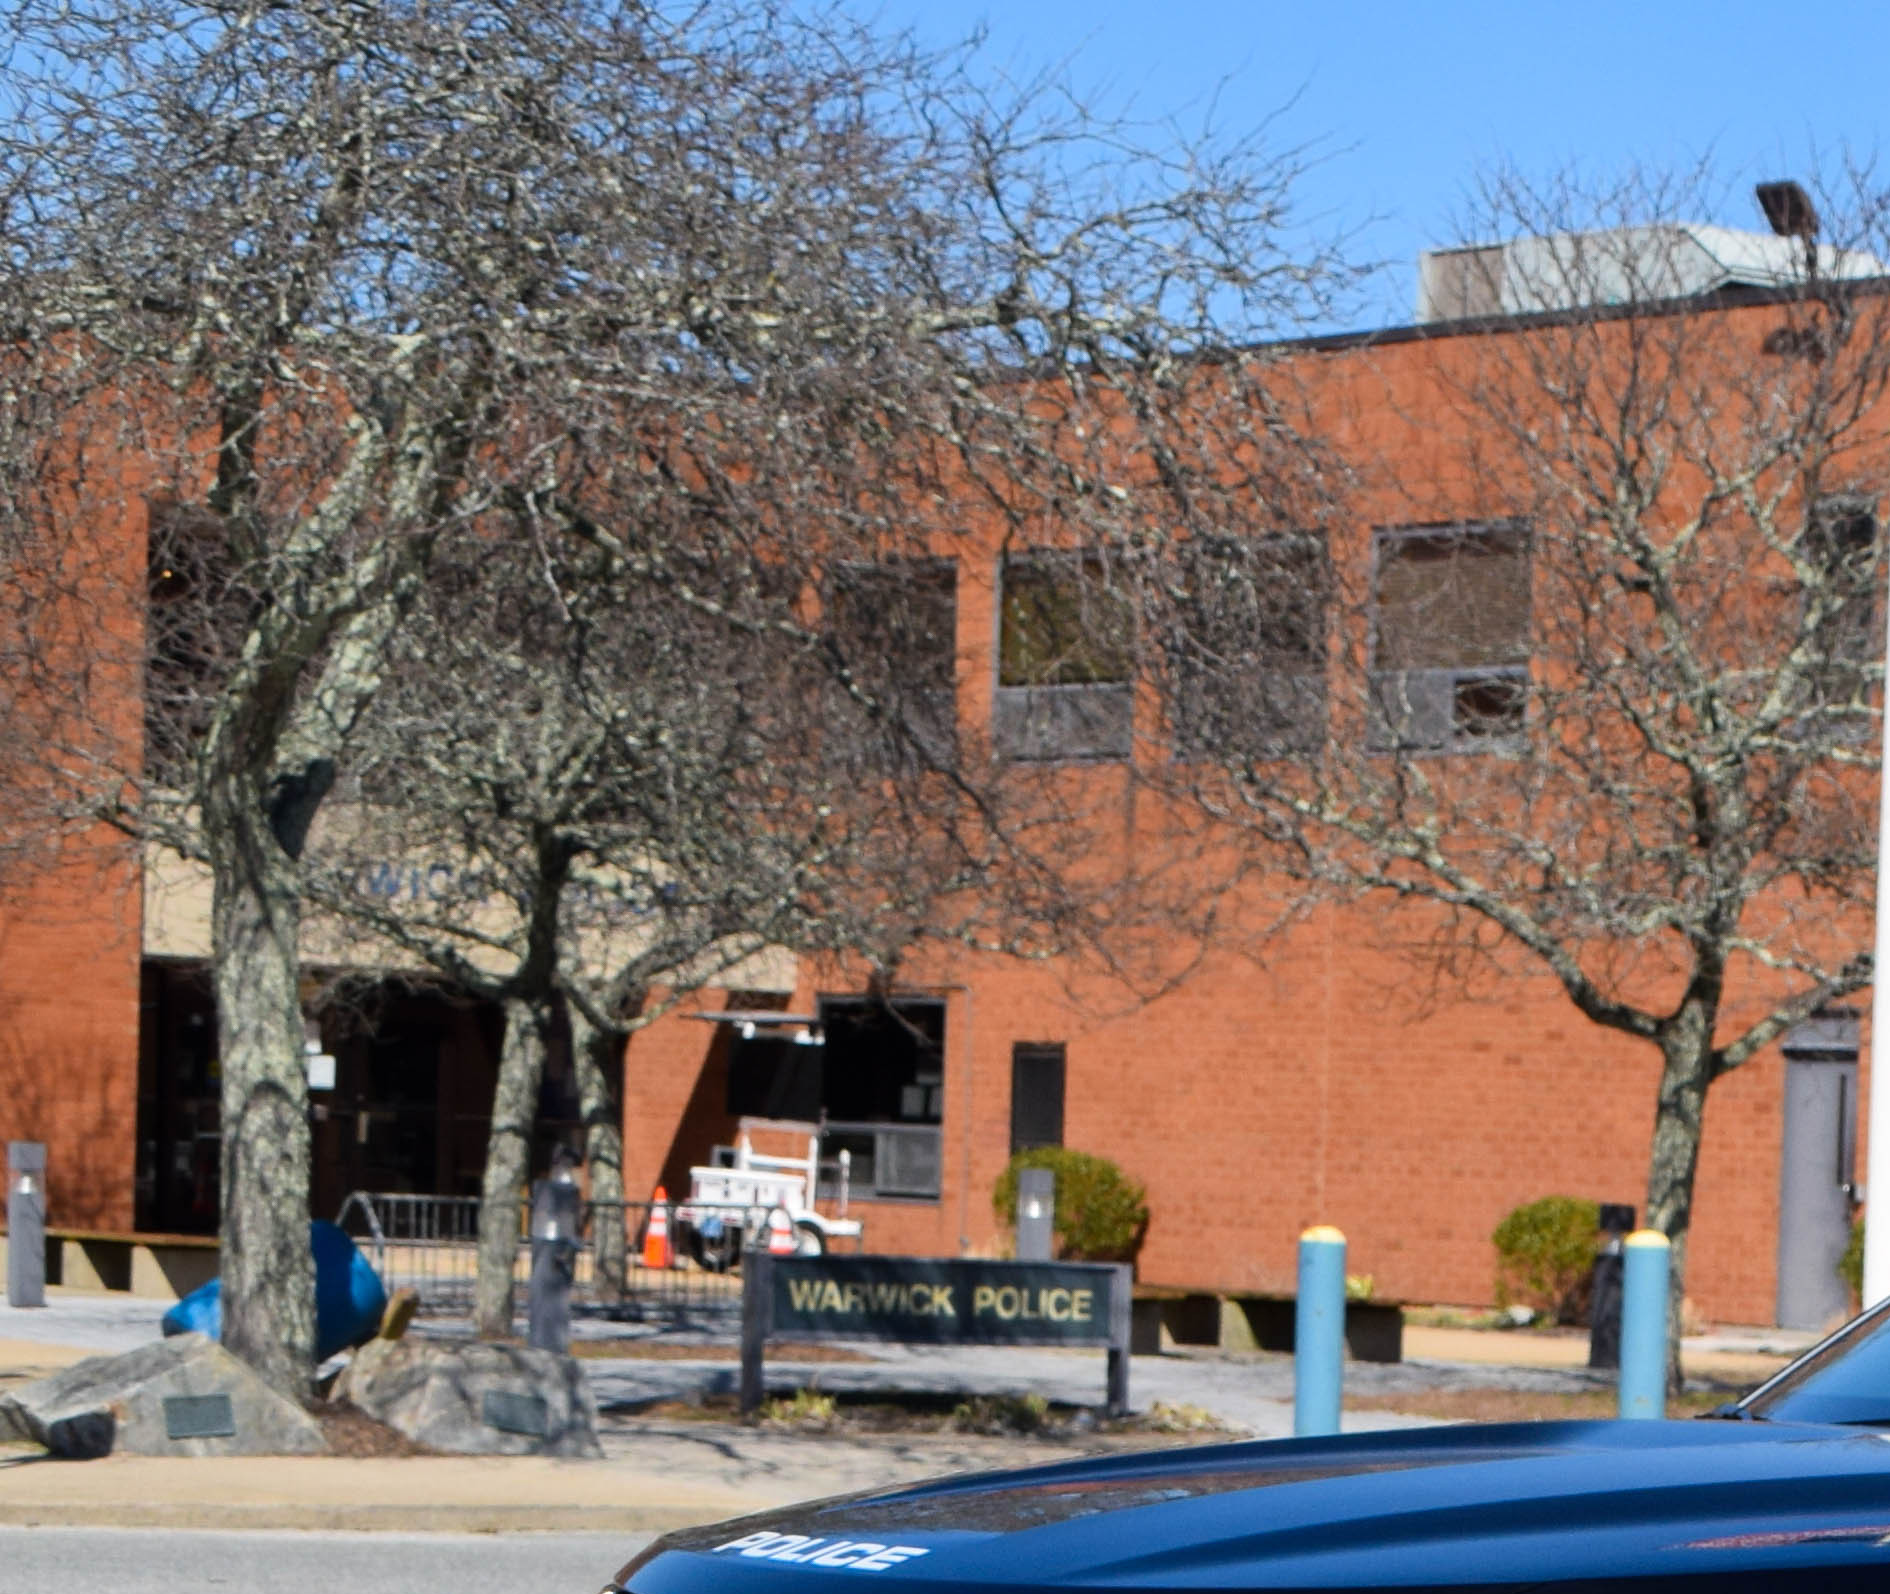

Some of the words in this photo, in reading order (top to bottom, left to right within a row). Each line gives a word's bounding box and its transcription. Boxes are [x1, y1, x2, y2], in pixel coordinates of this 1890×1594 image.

[788, 1278, 956, 1318] WARWICK
[973, 1284, 1094, 1322] POLICE
[712, 1531, 931, 1571] POLICE
